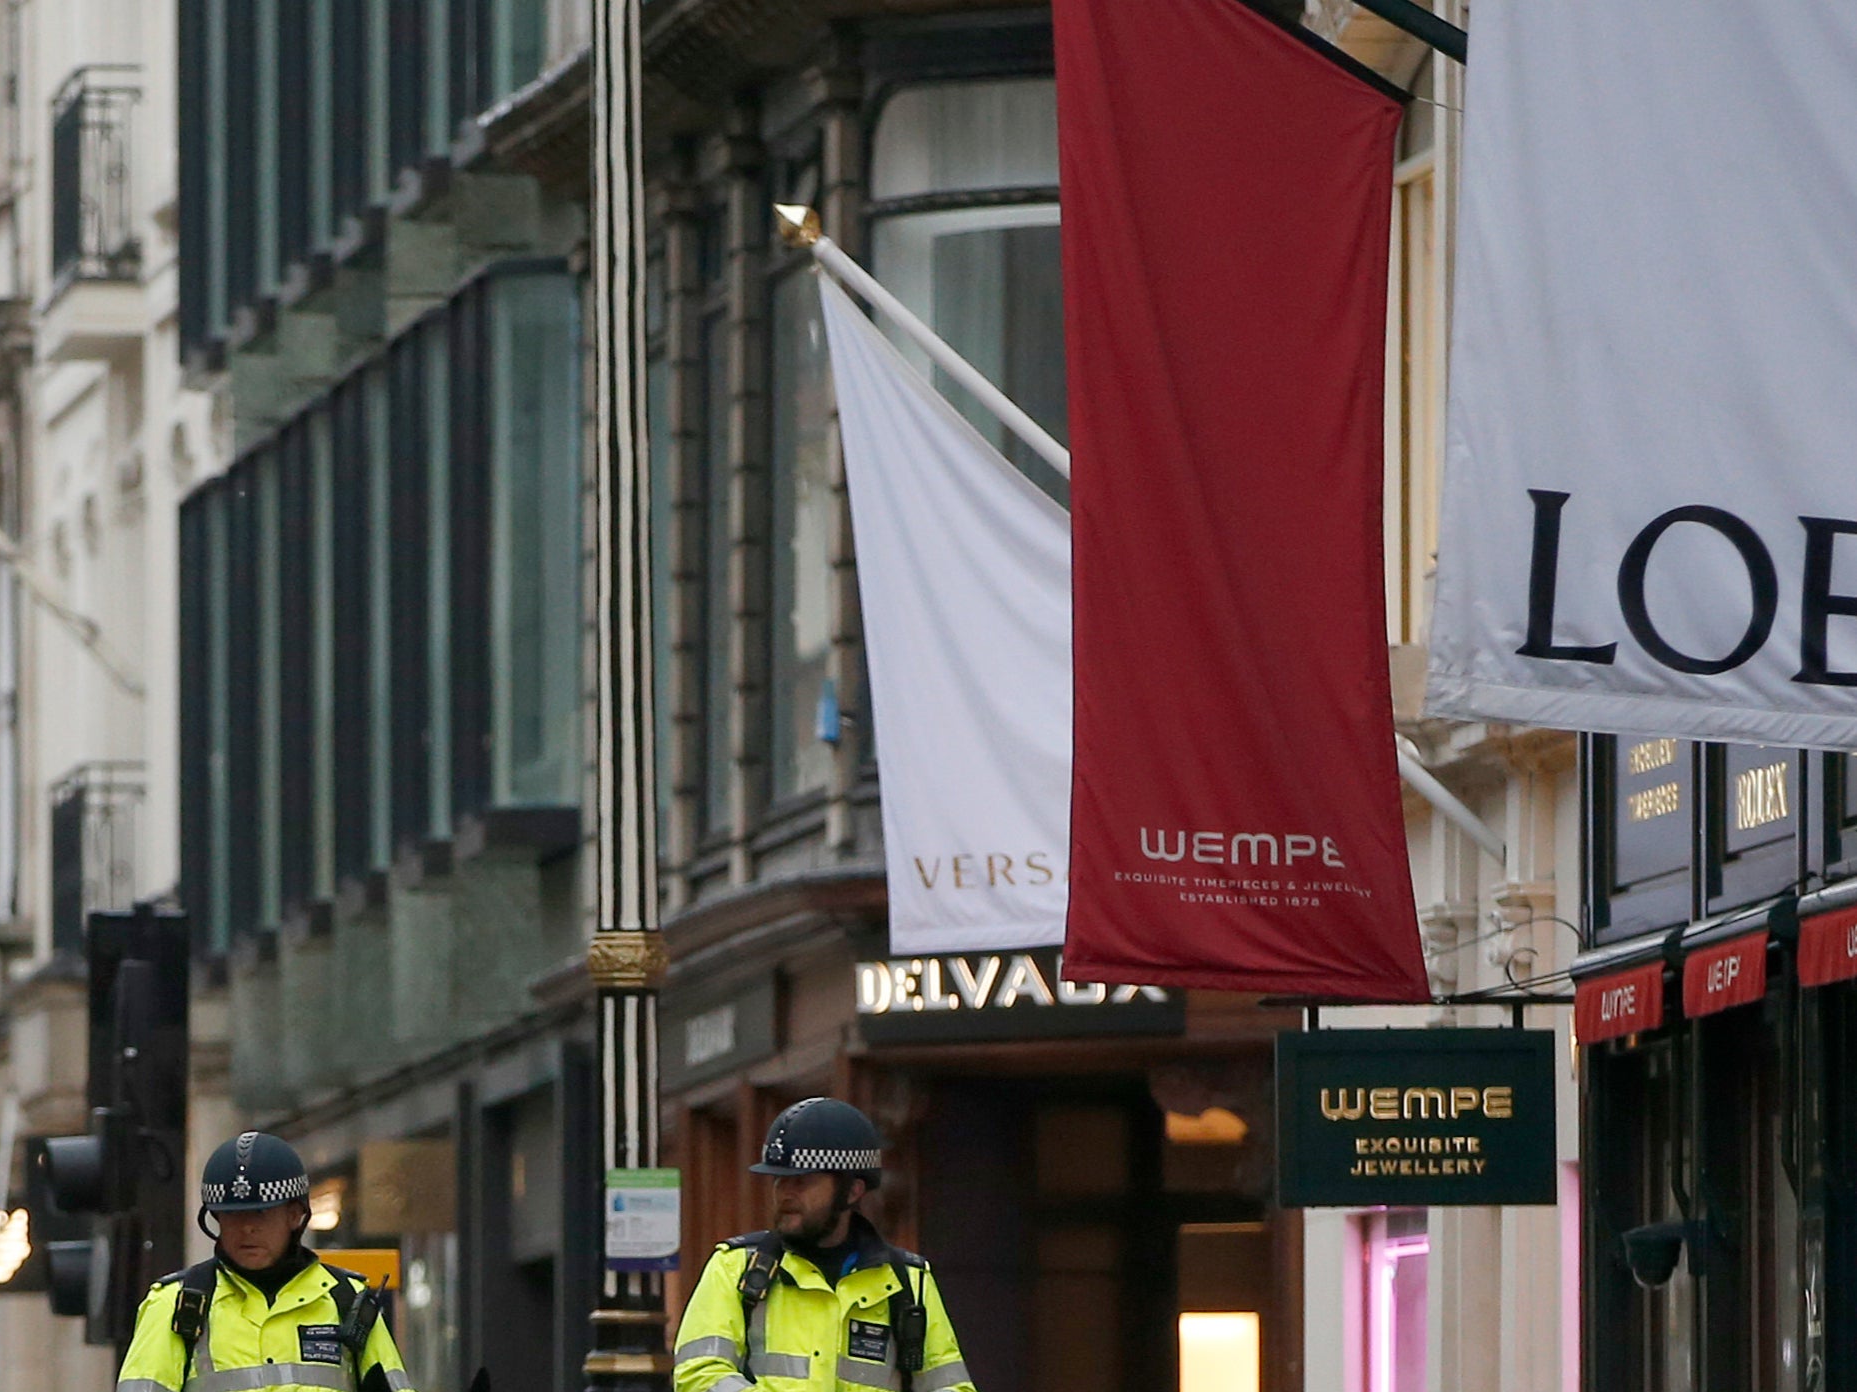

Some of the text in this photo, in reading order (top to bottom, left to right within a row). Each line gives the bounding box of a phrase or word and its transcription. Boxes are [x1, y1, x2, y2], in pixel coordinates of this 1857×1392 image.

[1140, 827, 1345, 868] WEMPE
[914, 851, 1070, 890] VERS
[1114, 871, 1186, 886] EXQUISITE
[1194, 877, 1280, 890] TIMEPIECES
[1179, 892, 1278, 906] ESTABLISHED
[1320, 1086, 1514, 1122] WEMPE
[1355, 1137, 1481, 1154] EXQUISITE
[1350, 1158, 1486, 1176] JEWELLERY
